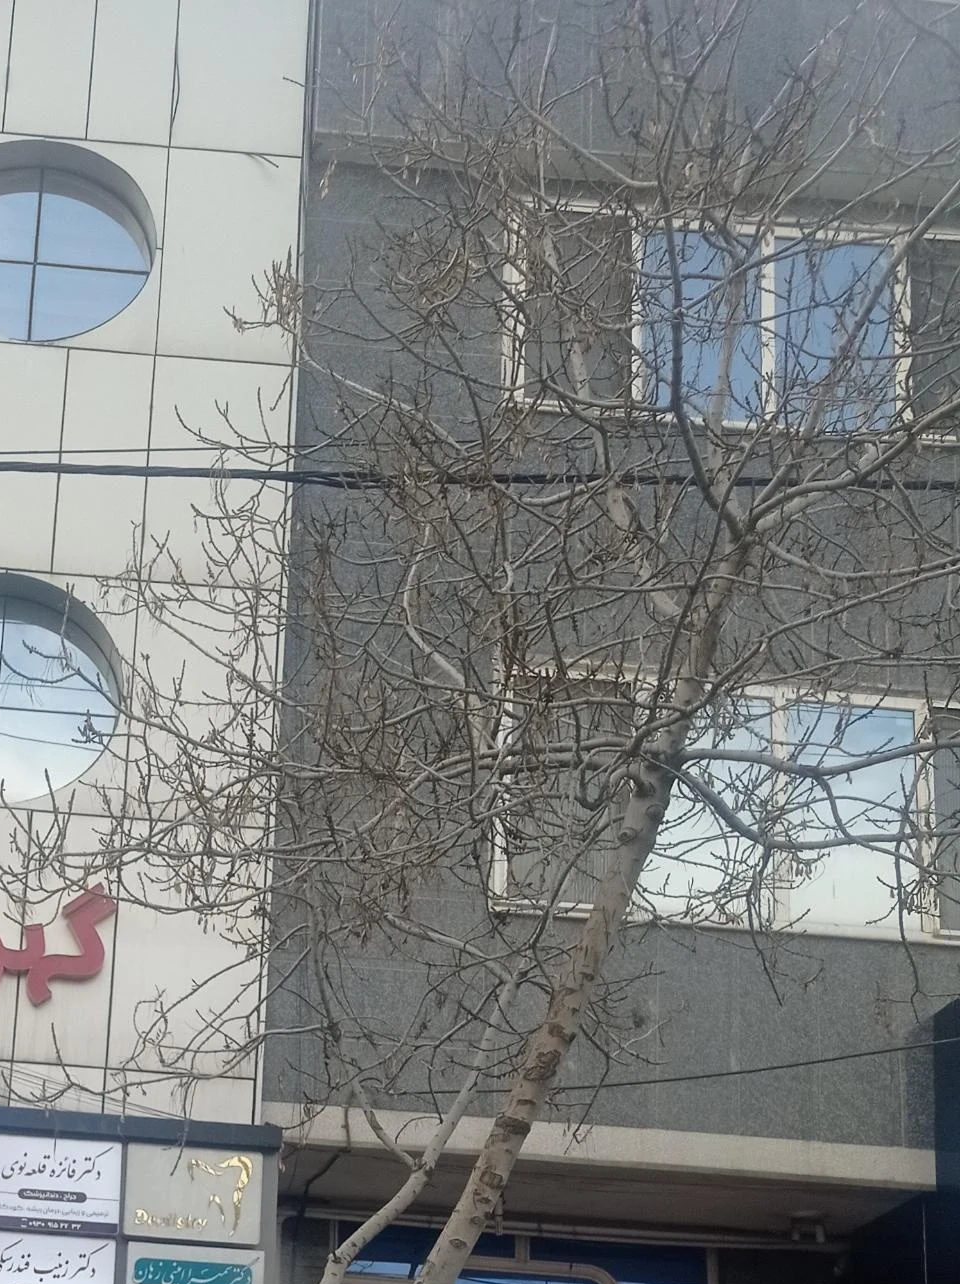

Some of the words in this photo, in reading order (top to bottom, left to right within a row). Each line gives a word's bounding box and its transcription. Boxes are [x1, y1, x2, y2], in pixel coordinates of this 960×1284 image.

[75, 1146, 114, 1182] دکتر
[34, 1252, 69, 1282] زینب
[69, 1243, 109, 1280] دکتر
